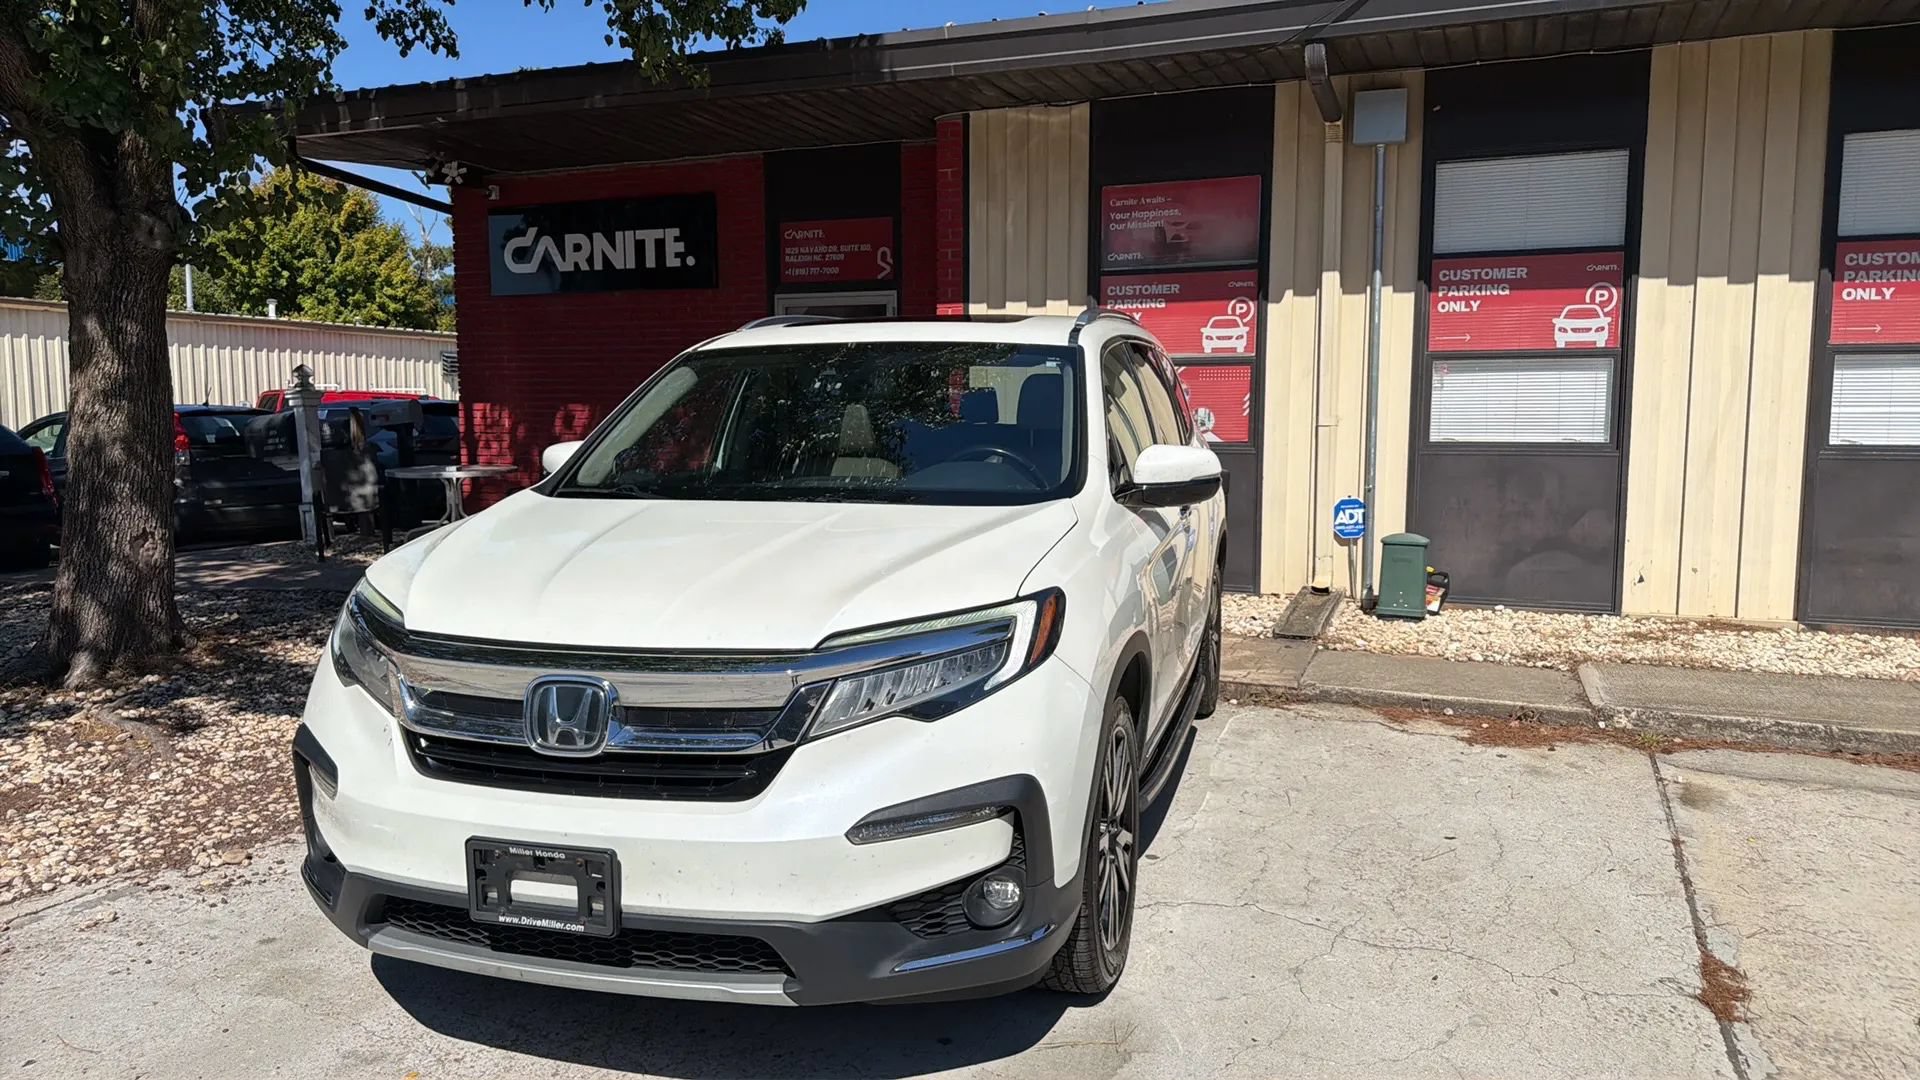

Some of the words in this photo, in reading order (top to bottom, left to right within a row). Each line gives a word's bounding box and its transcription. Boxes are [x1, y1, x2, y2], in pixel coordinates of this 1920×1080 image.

[1139, 196, 1166, 205] Awaits
[1110, 212, 1130, 220] Your
[1109, 222, 1126, 231] Our
[1127, 220, 1164, 229] Mission!
[1439, 267, 1528, 281] CUSTOMER
[1844, 270, 1920, 283] PARKIN
[1107, 284, 1180, 296] CUSTOMER
[1438, 284, 1510, 297] PARKING
[1842, 287, 1896, 301] ONLY
[1107, 298, 1166, 309] PARKING
[1437, 300, 1481, 312] ONLY
[1334, 508, 1365, 525] ADT
[509, 847, 533, 856] Miller
[535, 850, 566, 859] Honda
[498, 915, 584, 932] www.DriveMiller.com
